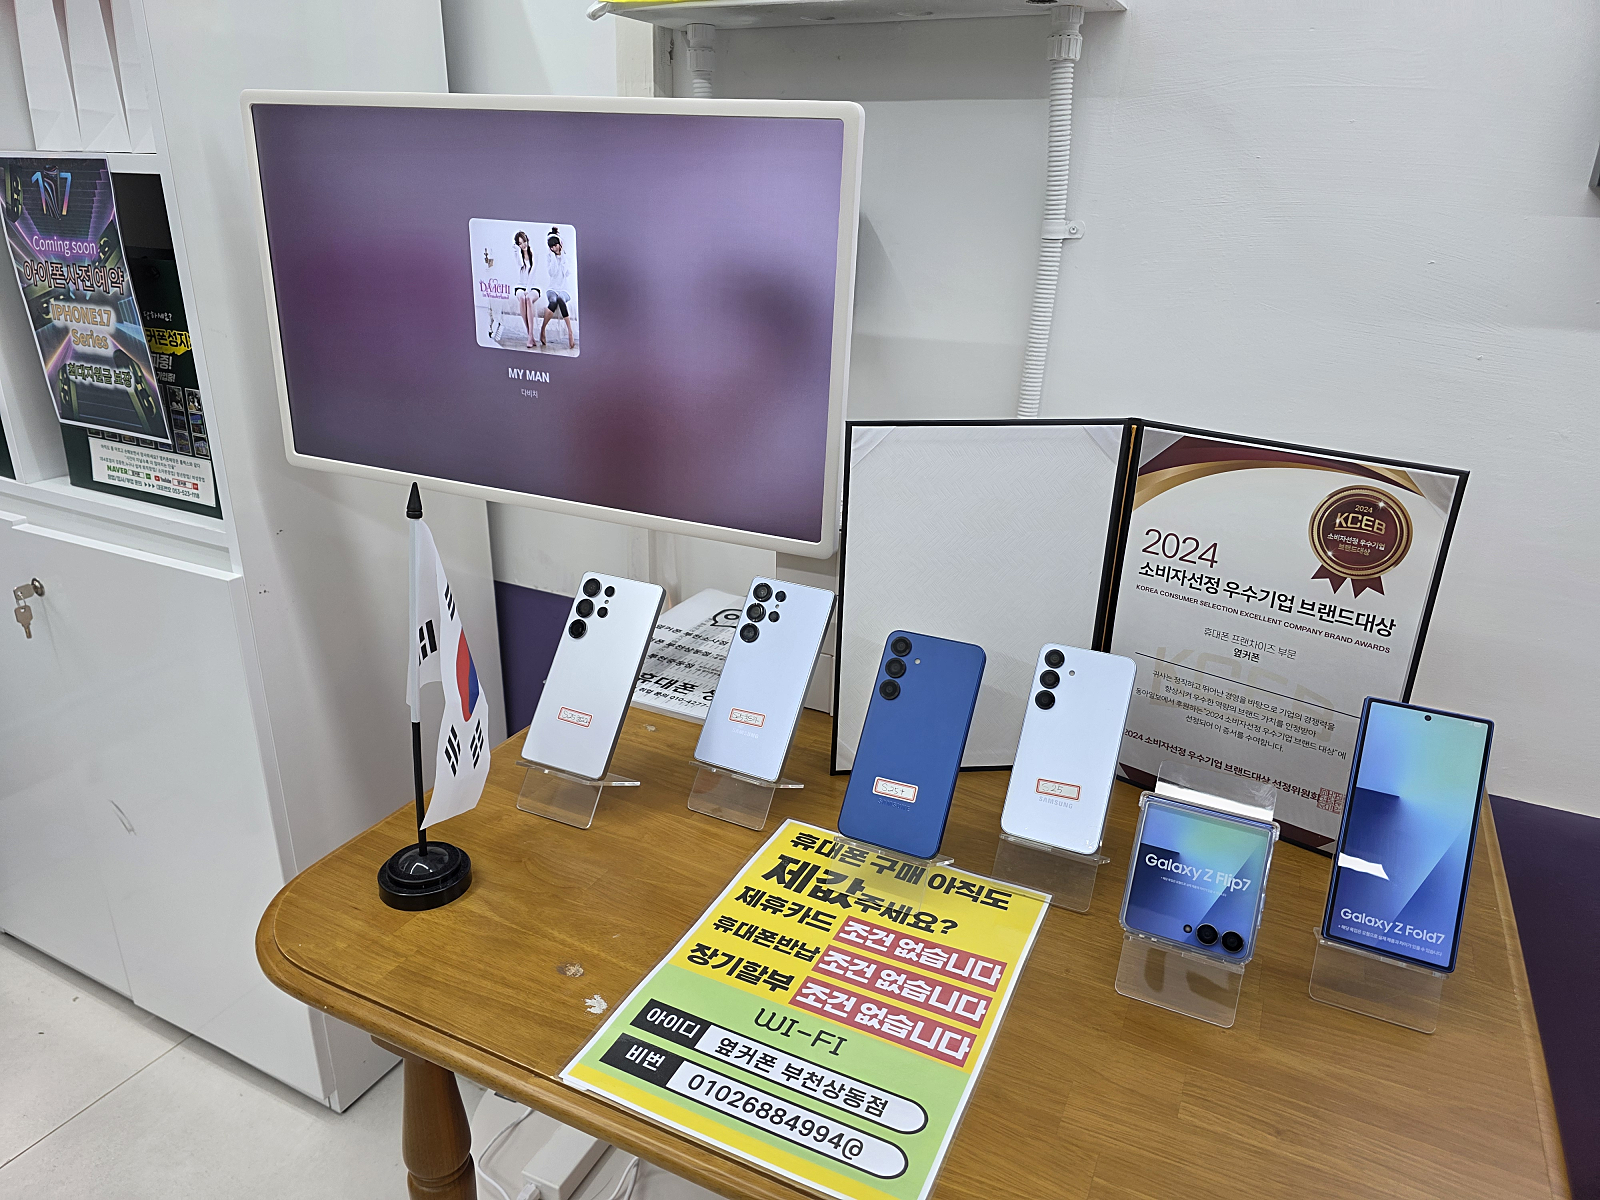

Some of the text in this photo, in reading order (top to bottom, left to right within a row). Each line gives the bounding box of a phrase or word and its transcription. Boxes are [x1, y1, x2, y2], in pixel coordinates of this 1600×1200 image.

[33, 235, 96, 256] Coming soon
[23, 260, 124, 295] 아이폰사전예약
[51, 304, 111, 326] IPHONE17
[72, 329, 109, 349] Series
[67, 362, 132, 388] 최대지원금 보장
[508, 368, 549, 383] MY MAN
[521, 389, 538, 398] 다비치
[106, 465, 128, 475] NAVER
[1335, 513, 1386, 535] KCEB
[1355, 505, 1373, 513] 2024
[1141, 528, 1219, 569] 2024
[1327, 533, 1386, 550] 소비자선정 우수기업
[1138, 561, 1398, 639] 소비자선정 우수기업 브랜드대상
[1136, 584, 1391, 654] KOREA CONSUMER SELECTION EXCELLENT COMPANY BRAND AWARDS
[1204, 627, 1297, 660] 휴대폰 프랜차이즈 부문
[1233, 647, 1260, 663] 옆커폰
[638, 672, 698, 694] 휴대폰
[1153, 670, 1172, 682] 귀사는
[1174, 676, 1202, 691] 정직하고
[1247, 698, 1278, 714] 바탕으로
[1280, 708, 1303, 722] 기업의
[1135, 688, 1175, 706] 동아일보에서
[1225, 716, 1262, 732] 소비자선정
[1262, 728, 1293, 744] 우수기업
[1294, 737, 1317, 751] 브랜드
[1186, 714, 1213, 730] 선정되어
[1214, 724, 1222, 733] 이
[1245, 734, 1284, 752] 수여합니다.
[1192, 693, 1214, 706] 우수한
[1238, 707, 1260, 720] 브랜드
[1260, 714, 1284, 728] 가치를
[1285, 722, 1317, 738] 인정받아
[1144, 736, 1186, 757] 소비자선정
[1188, 750, 1222, 768] 우수기업
[1224, 762, 1271, 784] 브랜드대상
[1272, 778, 1320, 802] 선정위원회
[877, 797, 911, 812] SAMSUNG
[881, 782, 906, 796] S25+
[1038, 796, 1073, 809] SAMSUNG
[1041, 781, 1064, 793] S25
[790, 831, 1012, 912] 휴대폰 구매 아직도
[1145, 853, 1202, 881] Galaxy
[1203, 864, 1213, 882] Z
[1215, 871, 1252, 892] Flip7
[734, 885, 1002, 988] 제휴카드 조건 없습니다
[1340, 908, 1445, 945] Galaxy Z Fold7
[713, 915, 987, 1022] 휴대폰반납 조건 없습니다
[686, 942, 971, 1061] 장기할부 조건 없습니다
[754, 1007, 848, 1056] WI-FI
[646, 1007, 888, 1119] 아이디 옆커폰 부천상동점
[625, 1044, 864, 1161] 비번 01026884994@
